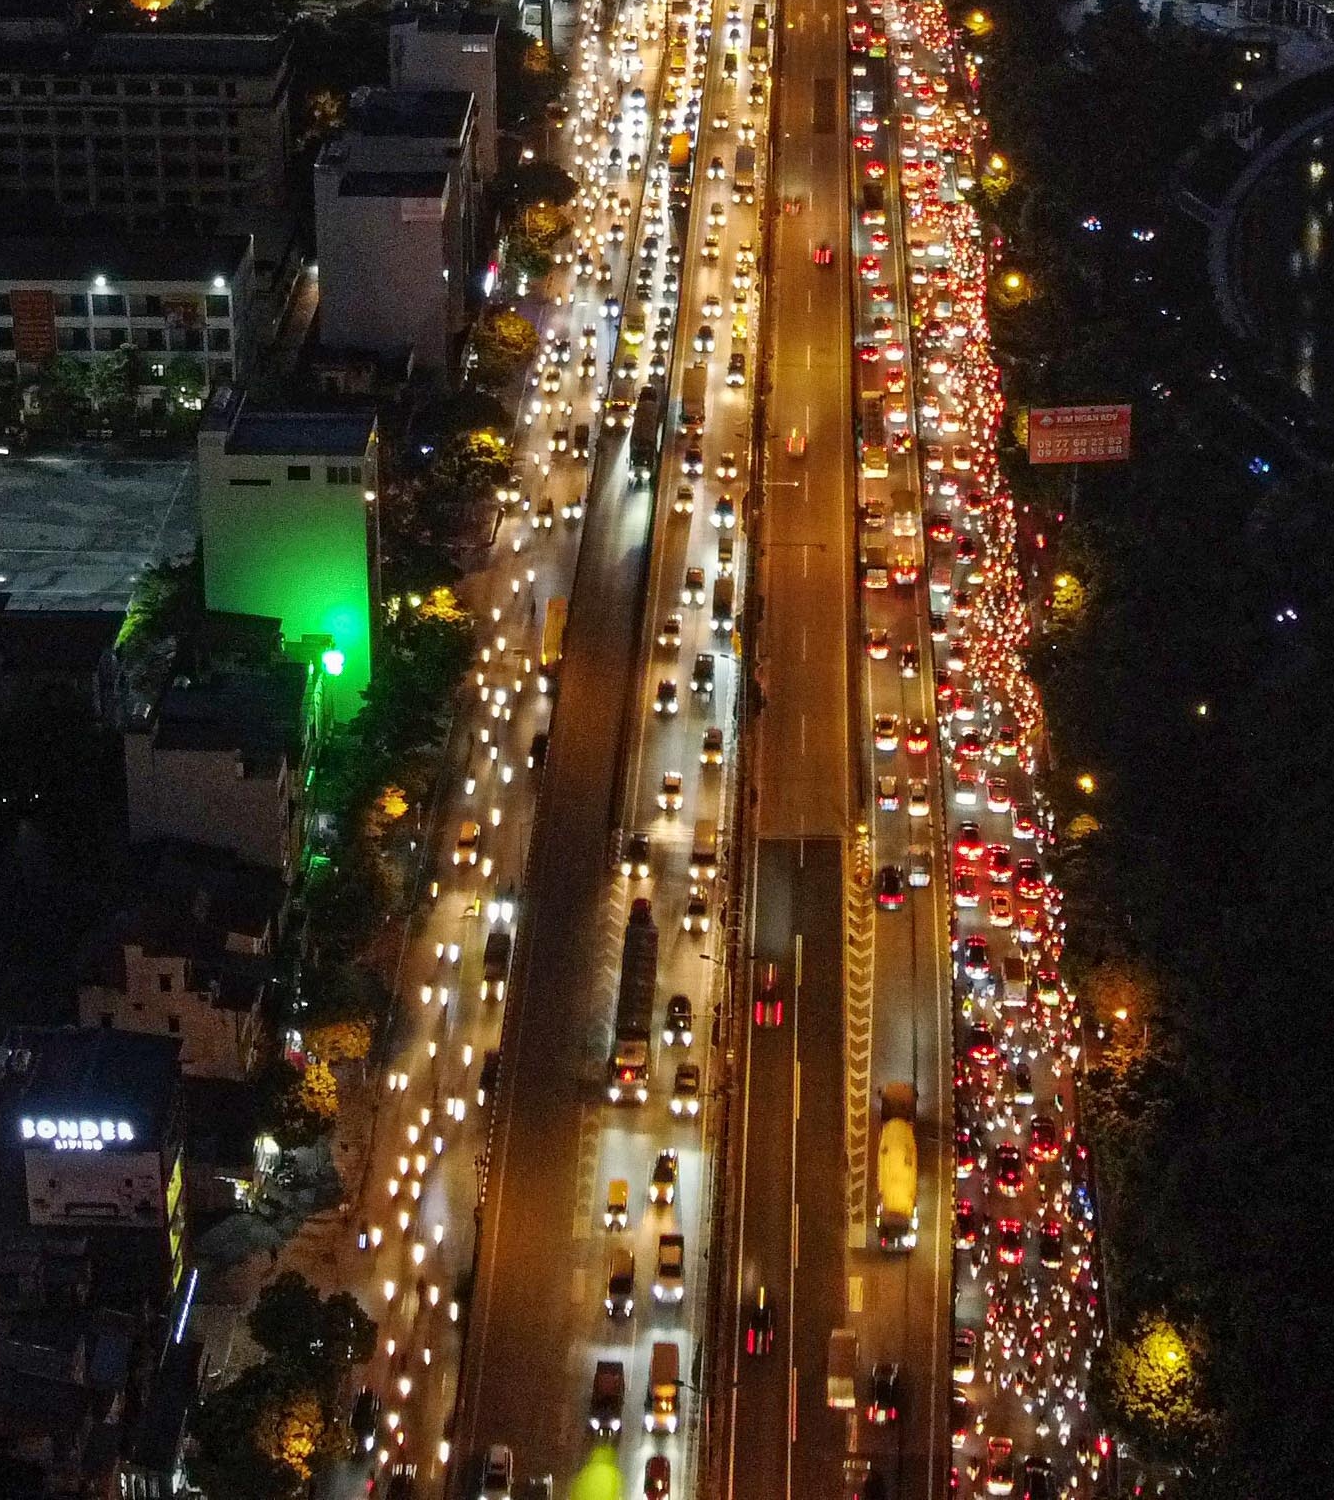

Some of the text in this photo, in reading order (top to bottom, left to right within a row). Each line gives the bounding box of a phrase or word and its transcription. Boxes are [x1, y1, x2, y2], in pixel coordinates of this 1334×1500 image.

[1056, 415, 1074, 423] KIM
[1054, 439, 1069, 448] 77
[1054, 448, 1069, 457] 77
[54, 1139, 104, 1151] LIVING
